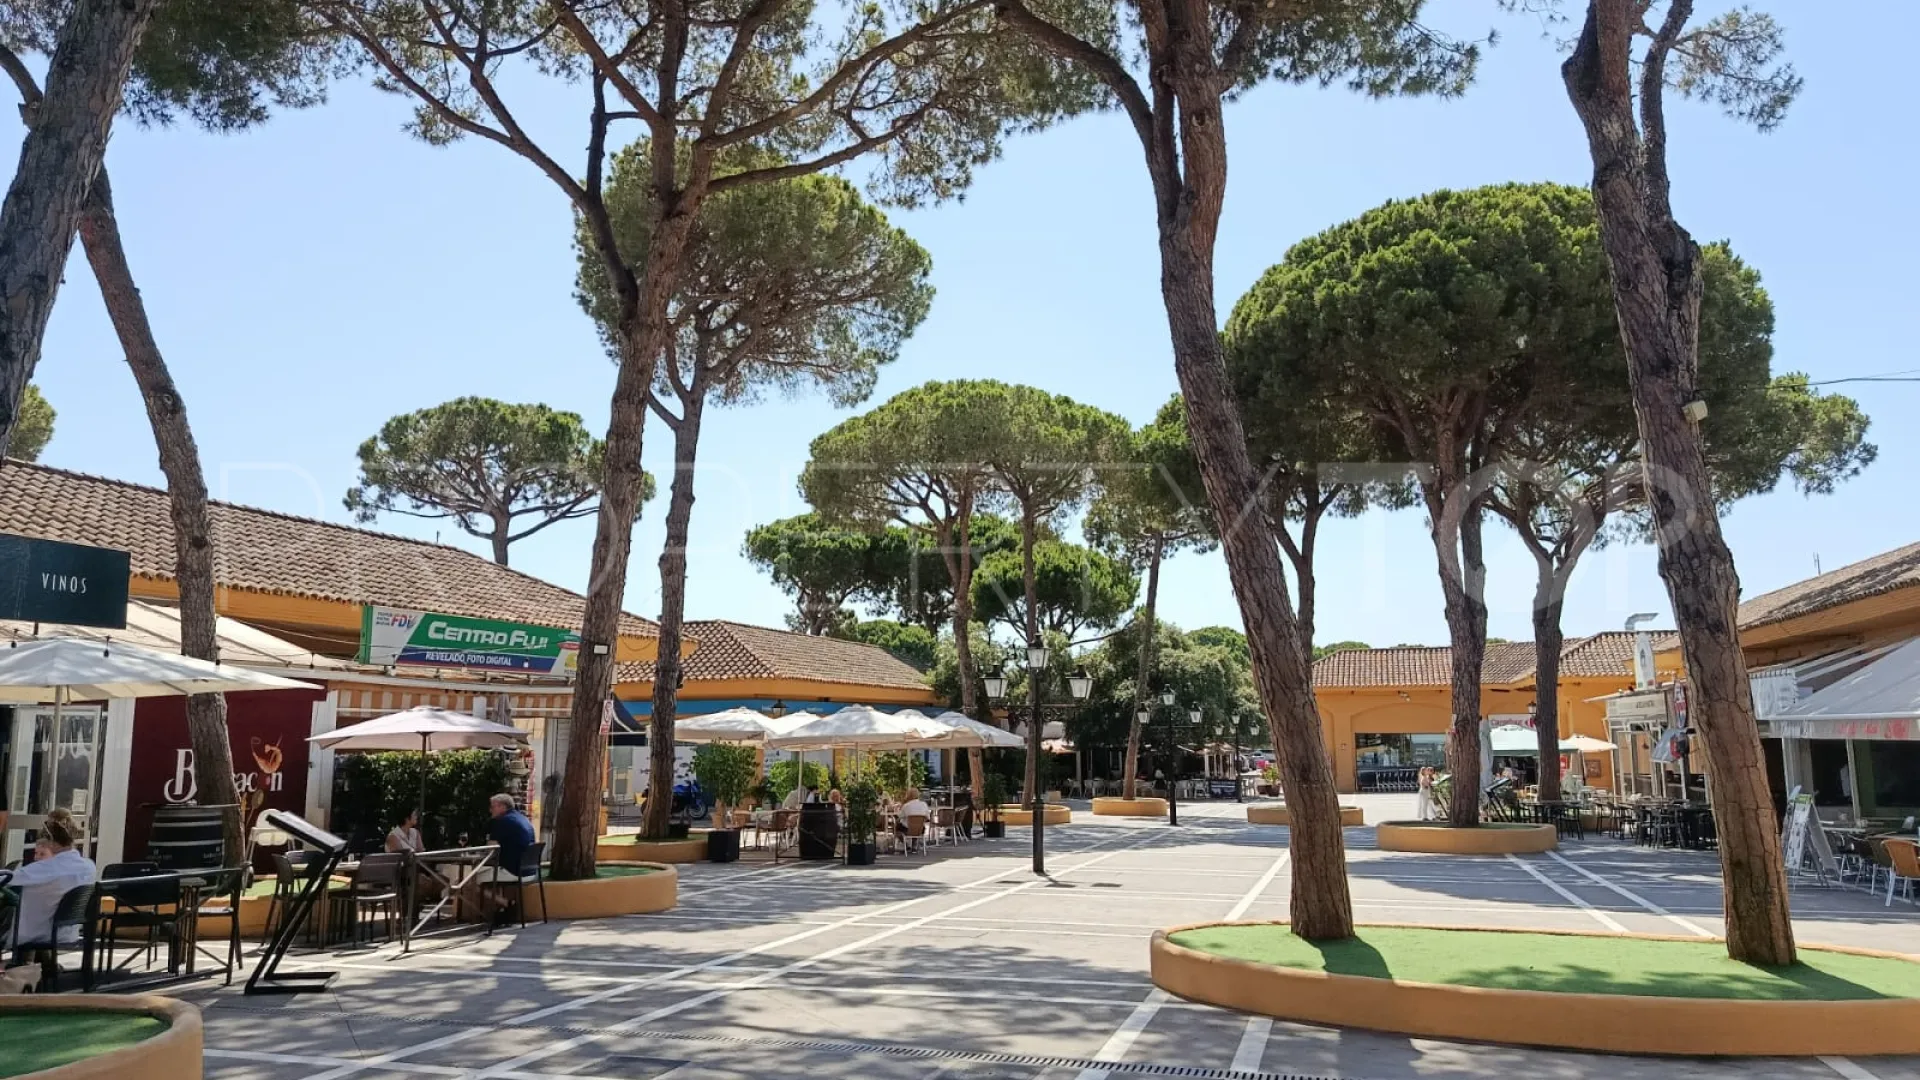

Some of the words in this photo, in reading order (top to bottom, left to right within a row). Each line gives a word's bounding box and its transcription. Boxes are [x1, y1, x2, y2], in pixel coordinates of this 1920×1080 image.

[41, 572, 88, 594] VINOS
[427, 620, 508, 645] CENTRO
[466, 654, 486, 664] FOTO
[486, 655, 512, 666] DIGITAL
